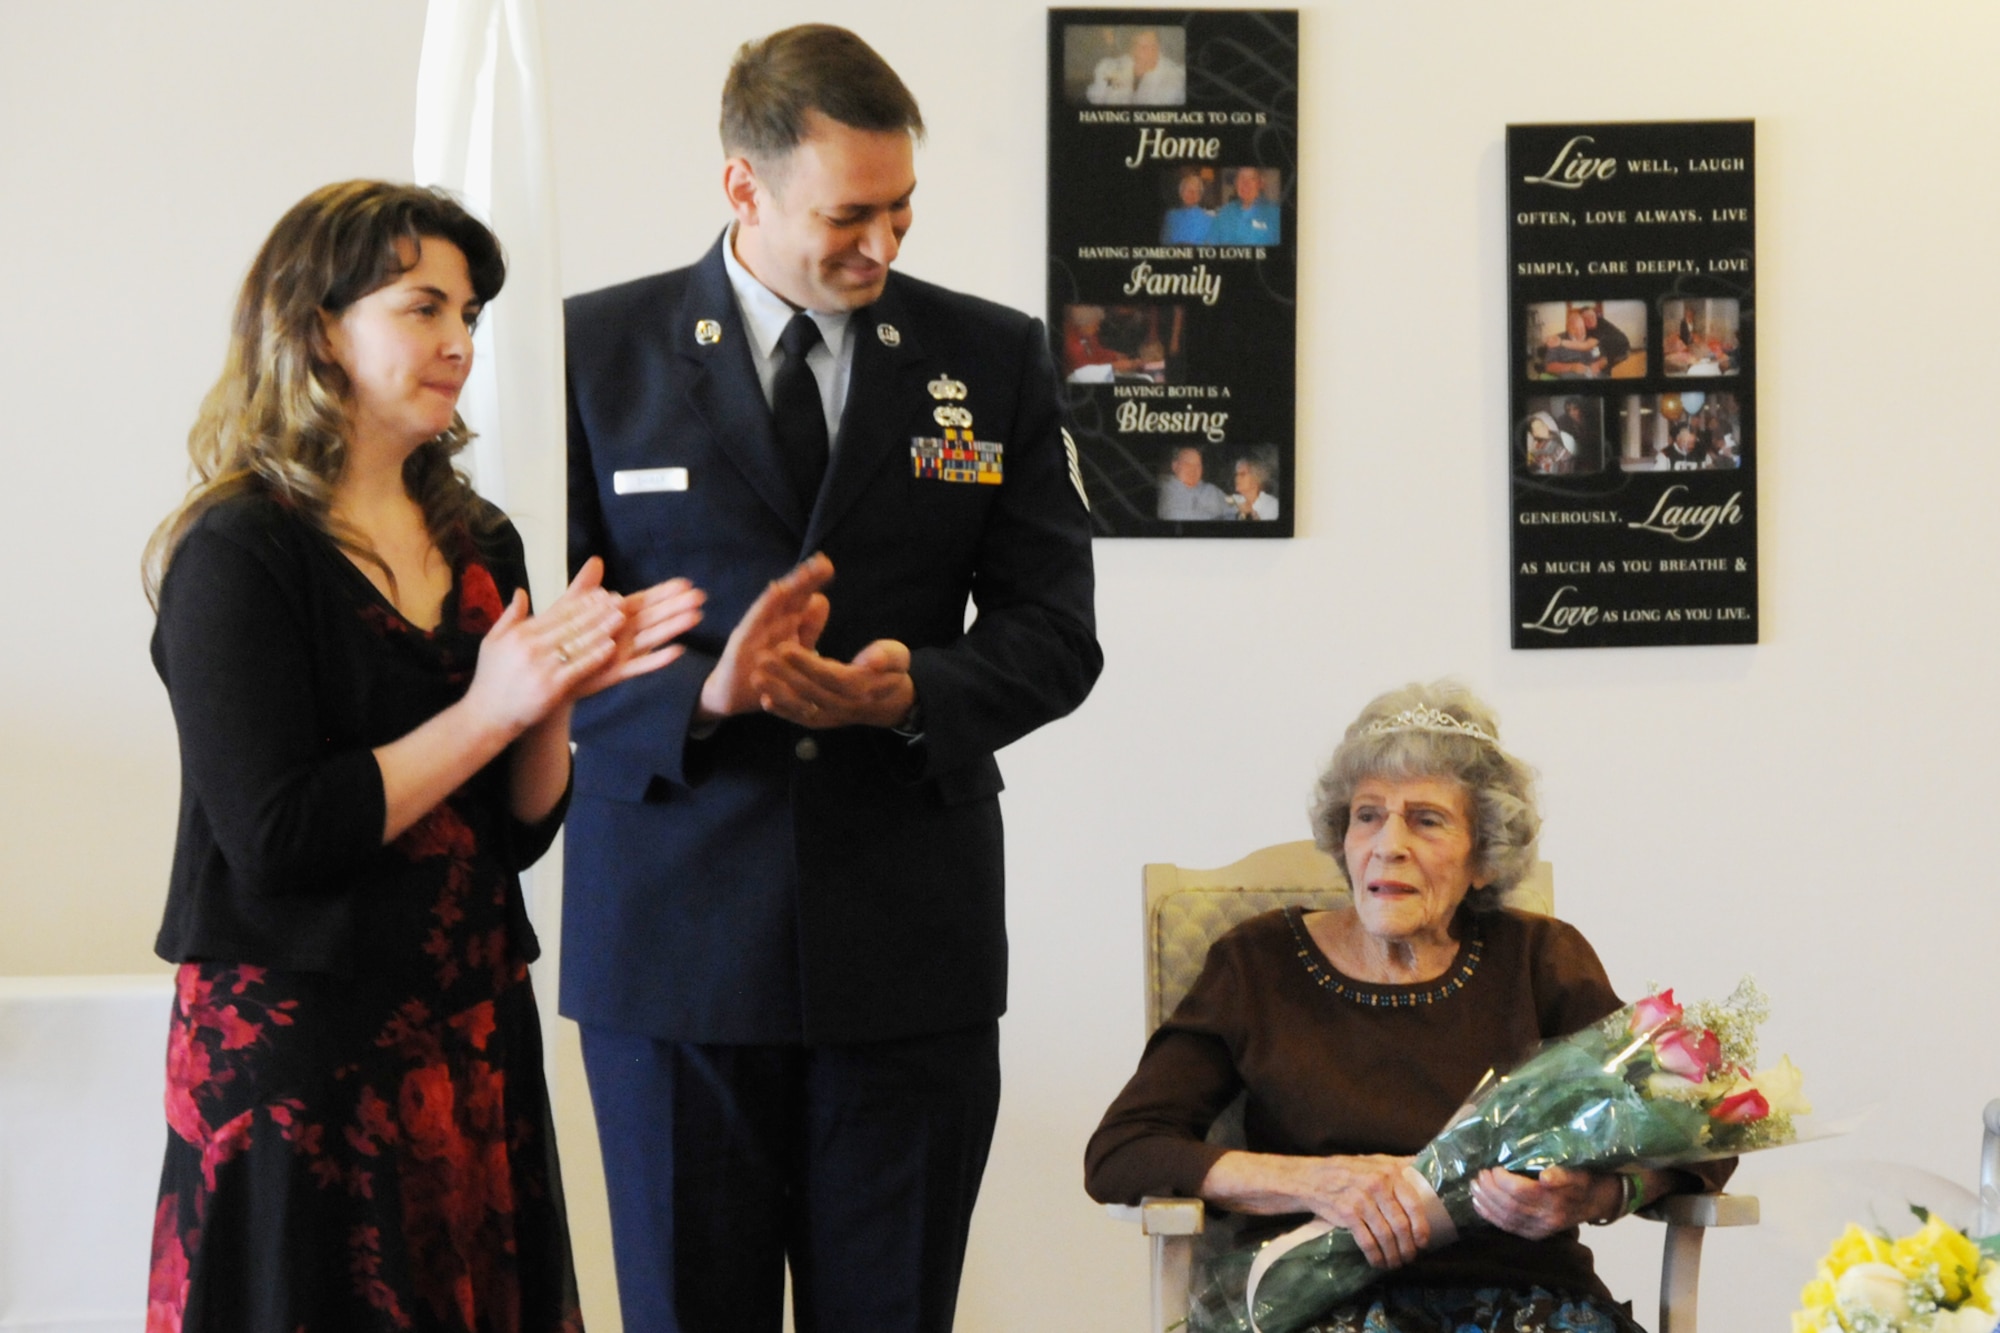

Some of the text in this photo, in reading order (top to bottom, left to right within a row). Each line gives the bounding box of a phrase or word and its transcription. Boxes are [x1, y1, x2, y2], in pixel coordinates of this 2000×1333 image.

[1079, 111, 1266, 123] HAVING SOMEPLACE TO GO IS
[1125, 128, 1220, 168] Home
[1524, 135, 1745, 189] Live WELL, LAUGH
[1517, 209, 1747, 226] OFTEN, LOVE ALWAYS. LIVE
[1079, 247, 1266, 258] HAVING SOMEONE TO LOVE IS
[1518, 259, 1748, 276] SIMPLY, CARE DEEPLY, LOVE
[1124, 261, 1220, 305] Family
[1114, 386, 1230, 397] HAVING BOTH IS A
[1116, 400, 1228, 441] Blessing
[1520, 485, 1743, 542] GENEROUSLY. Laugh
[1520, 557, 1747, 574] AS MUCH AS YOU BREATHE &
[1522, 586, 1750, 634] Love AS LONG AS YOU LIVE.
